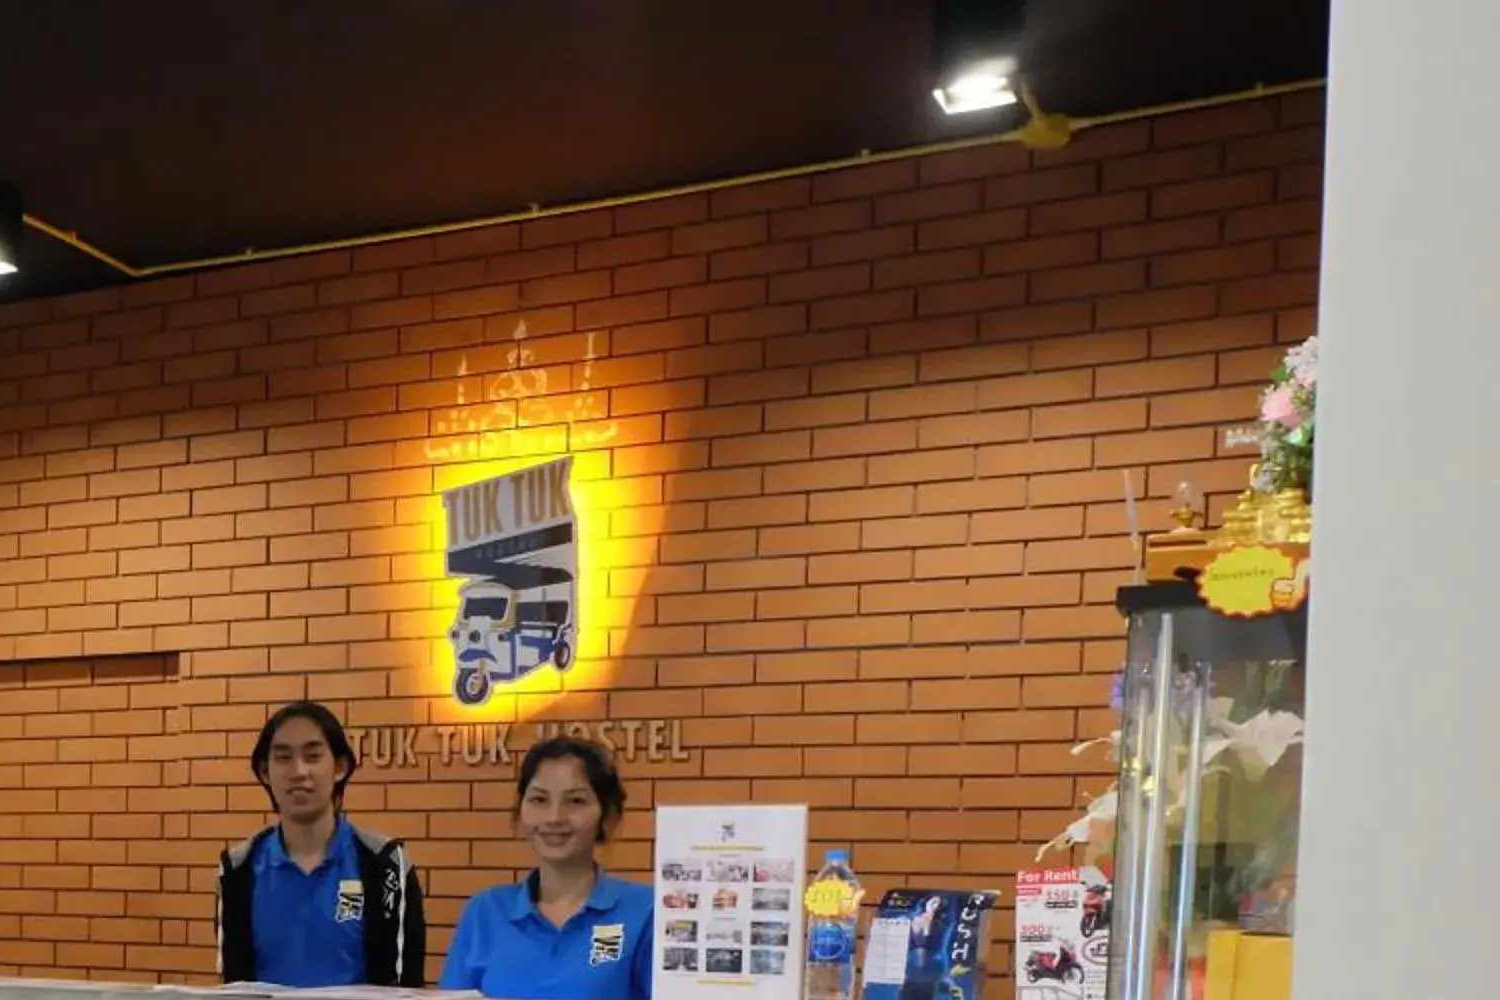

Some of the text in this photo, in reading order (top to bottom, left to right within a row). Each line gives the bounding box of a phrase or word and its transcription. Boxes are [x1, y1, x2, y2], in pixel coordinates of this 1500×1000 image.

[445, 460, 570, 546] TUK TUK
[349, 724, 418, 768] TUK
[437, 721, 514, 766] TUK
[1017, 868, 1077, 883] For Rent
